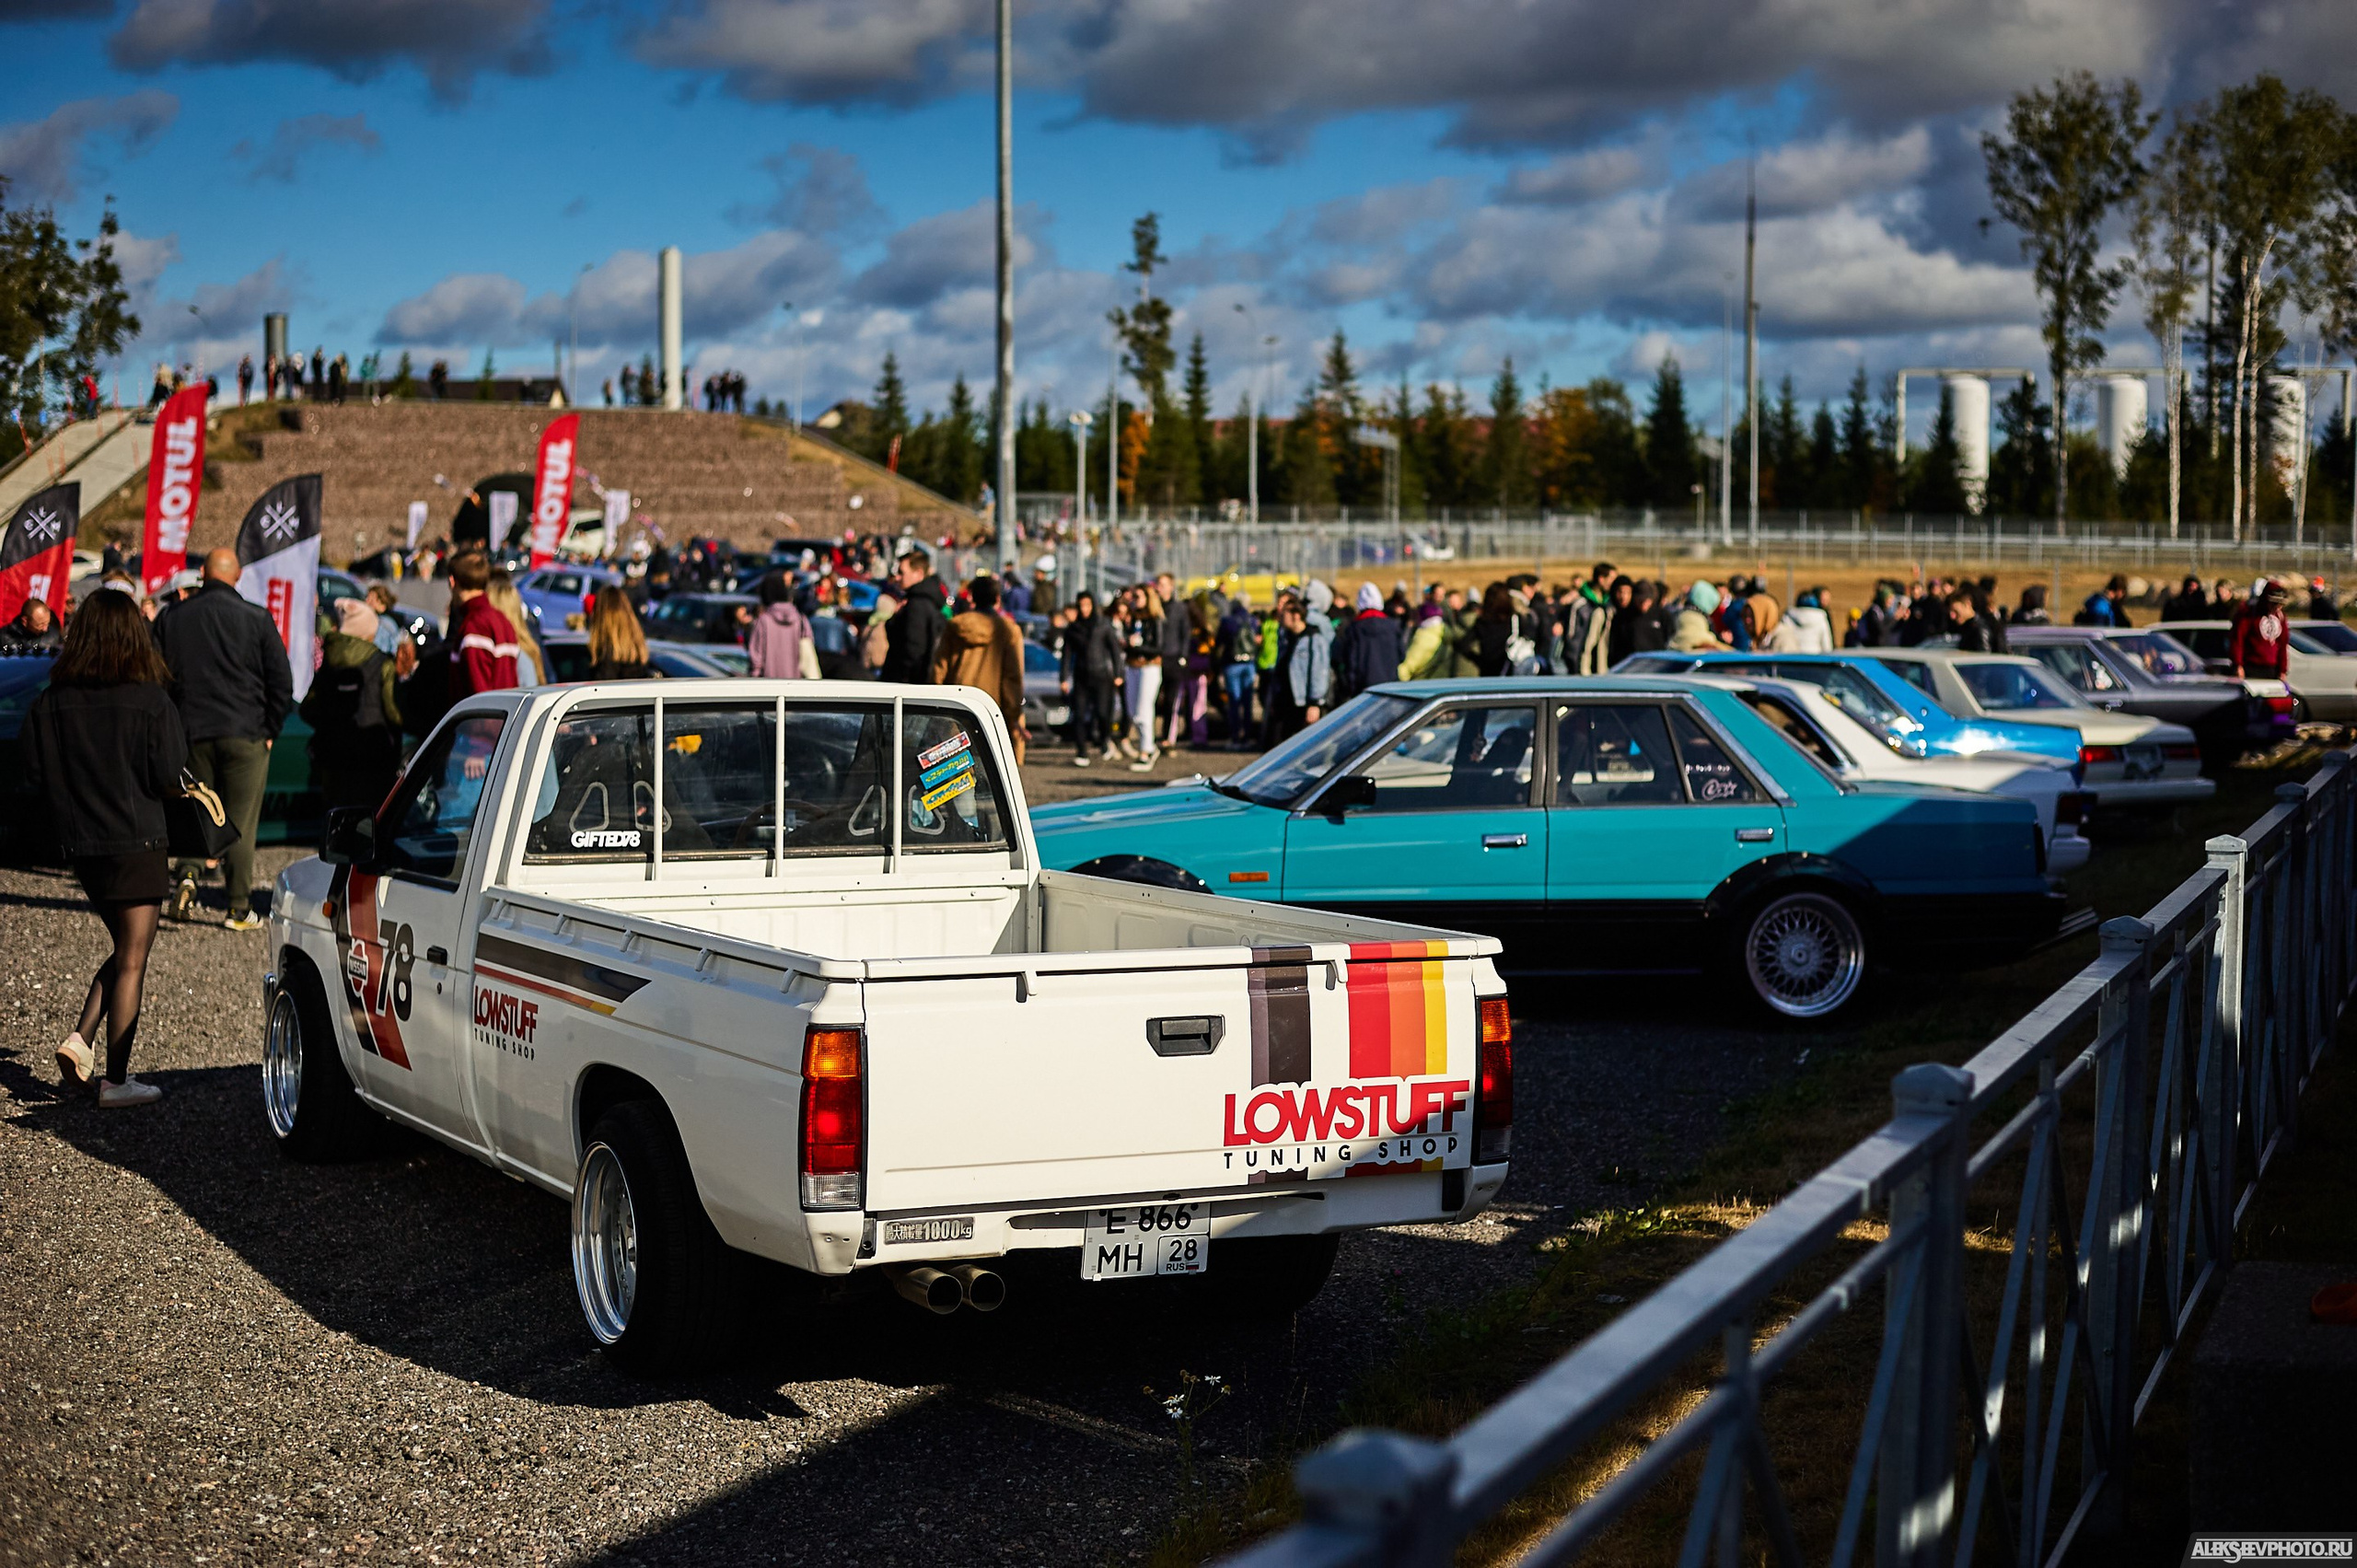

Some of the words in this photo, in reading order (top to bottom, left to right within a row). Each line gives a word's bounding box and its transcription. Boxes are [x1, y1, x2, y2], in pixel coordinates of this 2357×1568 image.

[157, 415, 198, 554] MOTUL
[533, 438, 573, 555] MOTUL
[571, 830, 641, 848] GIFTED78
[349, 958, 366, 977] NISSAN
[377, 918, 415, 1022] 78
[474, 985, 539, 1043] LOWSTUFF
[474, 1028, 506, 1051] TUNING
[512, 1041, 535, 1061] SHOP
[1224, 1080, 1470, 1146] LOWSTUFF
[1224, 1145, 1352, 1169] TUNING
[1377, 1137, 1458, 1159] SHOP
[1139, 1203, 1191, 1232] 866
[1097, 1243, 1144, 1273] MH
[1168, 1238, 1198, 1261] 28
[1166, 1262, 1184, 1272] RUS
